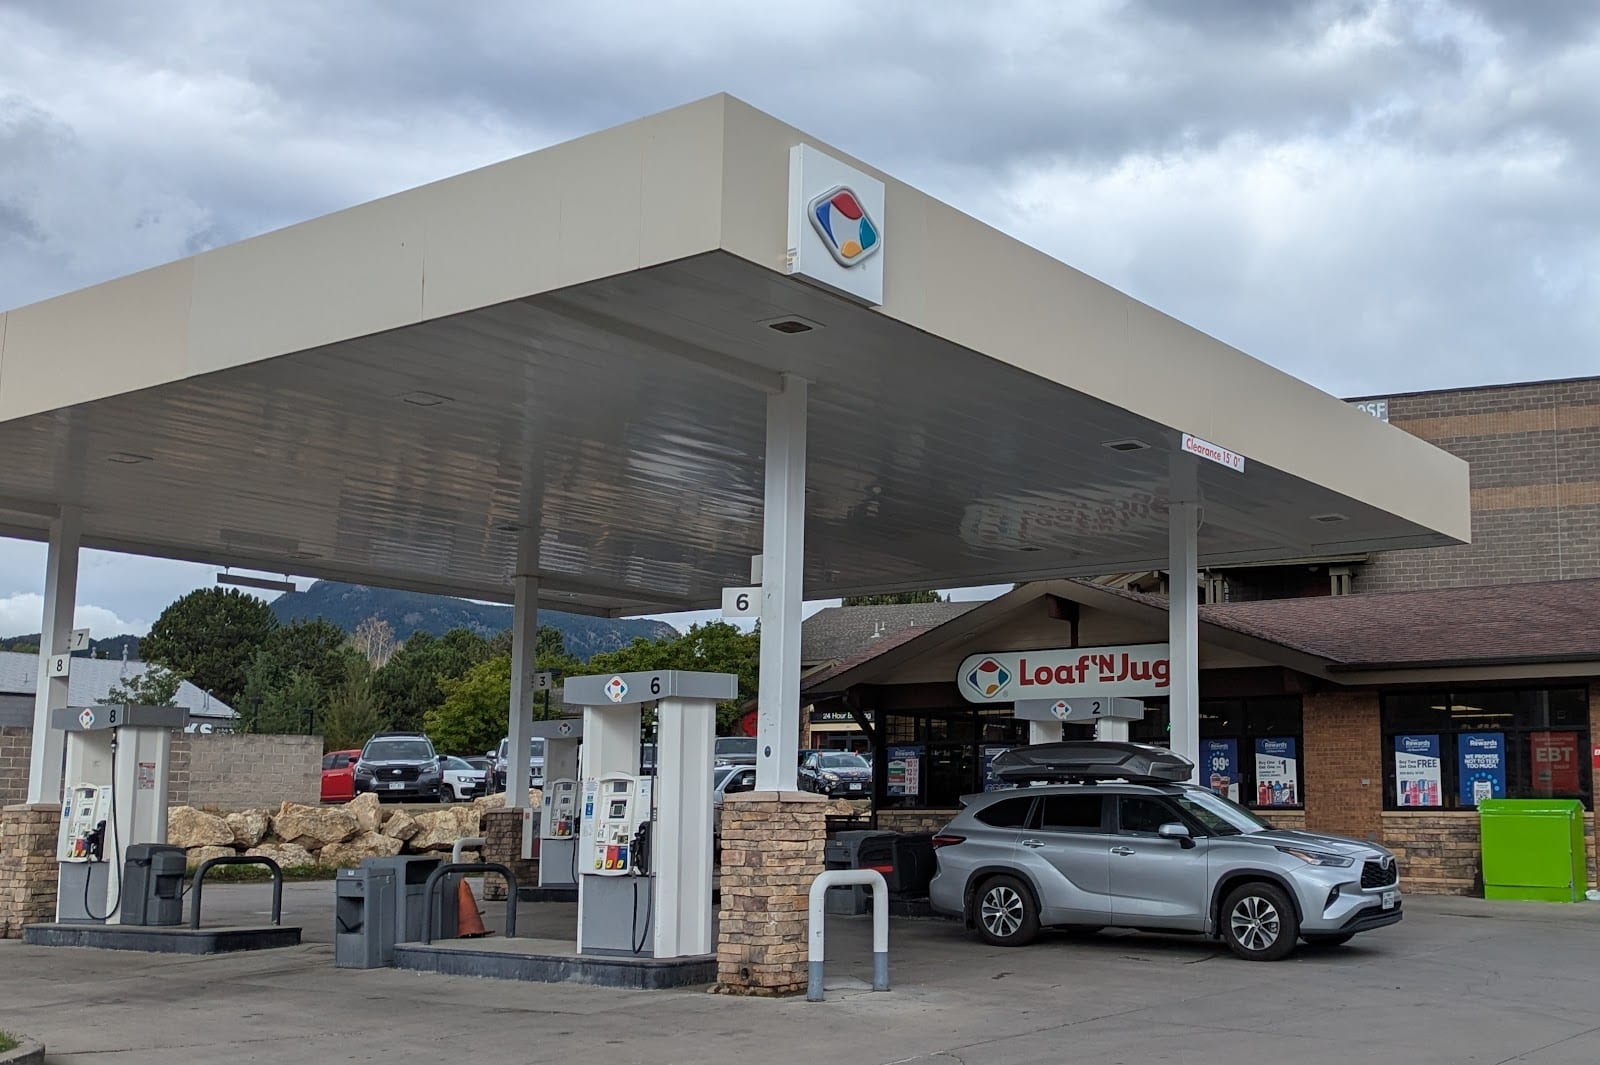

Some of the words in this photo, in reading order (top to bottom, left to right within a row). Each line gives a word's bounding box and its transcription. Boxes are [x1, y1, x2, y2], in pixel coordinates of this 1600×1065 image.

[1186, 438, 1221, 460] Clearance
[736, 593, 749, 611] 6
[77, 633, 84, 646] 7
[56, 659, 63, 672] 8
[539, 676, 546, 687] 3
[650, 676, 660, 694] 6
[1092, 701, 1101, 715] 2
[109, 709, 116, 723] 8
[1536, 747, 1574, 762] EBT
[1417, 759, 1438, 769] FREE
